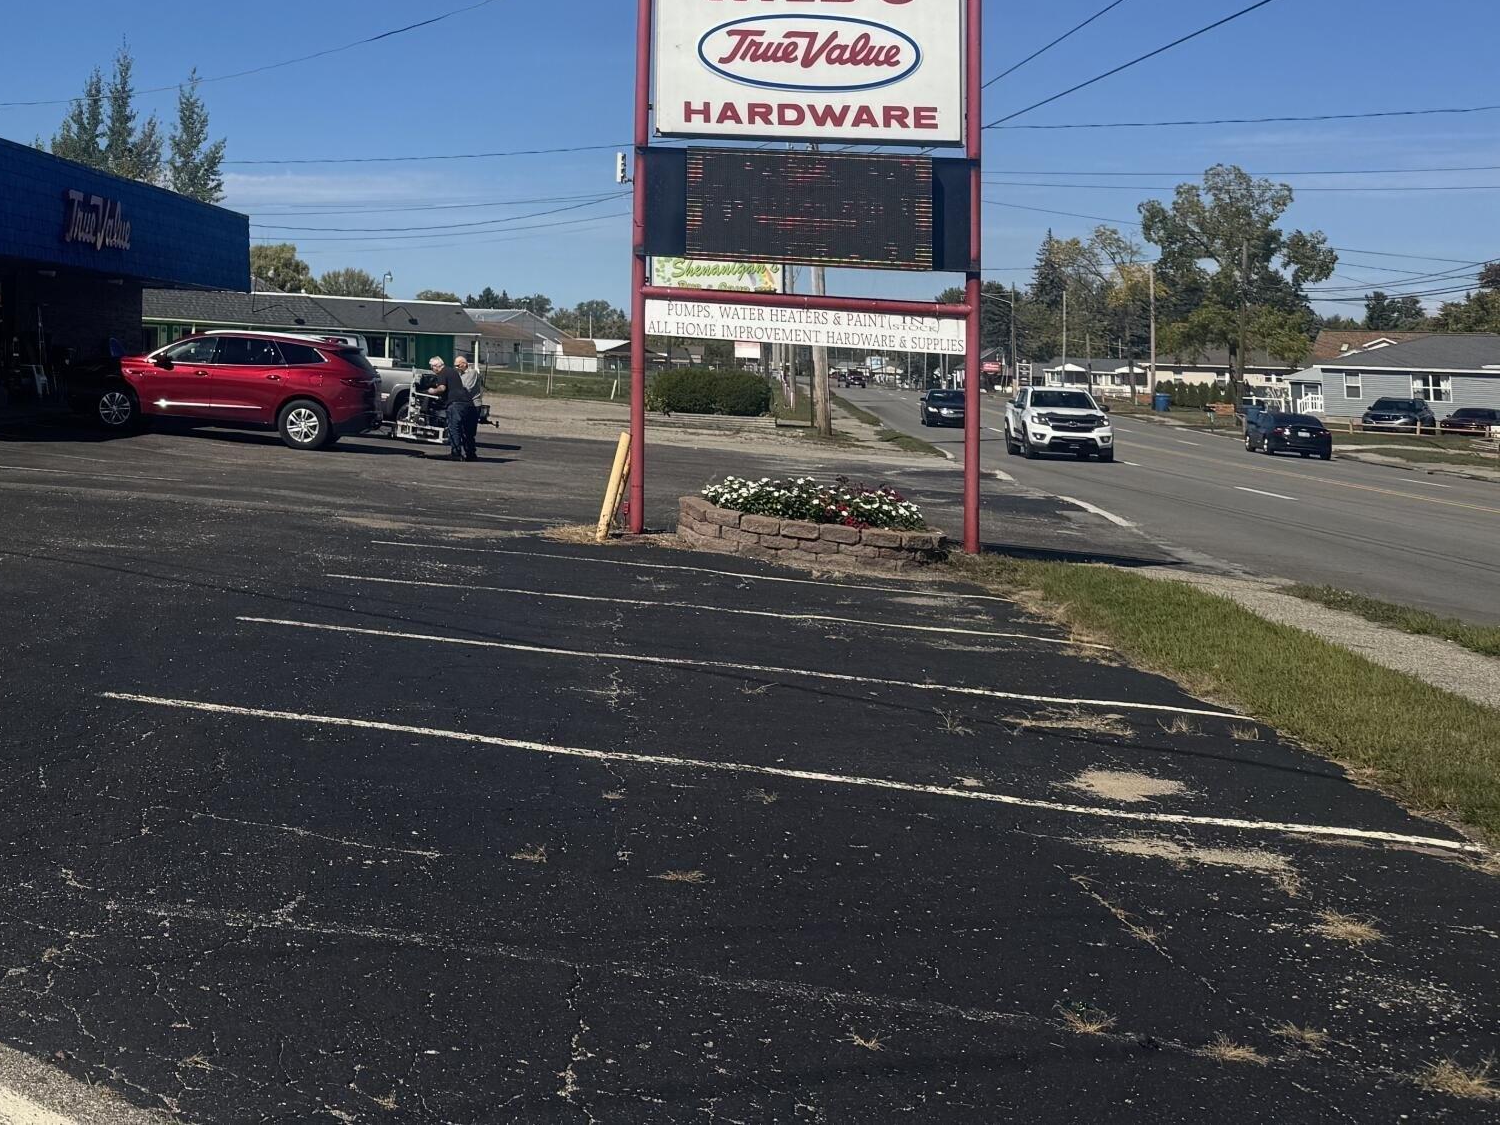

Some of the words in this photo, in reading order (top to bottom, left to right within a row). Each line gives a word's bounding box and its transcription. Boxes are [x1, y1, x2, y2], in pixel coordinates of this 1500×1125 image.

[683, 101, 939, 130] HARDWARE
[668, 303, 713, 319] PUMPS,
[719, 306, 765, 321] WATER
[770, 309, 828, 325] HEATERS
[833, 313, 841, 325] &
[648, 321, 671, 334] ALL
[676, 322, 716, 336] HOME
[722, 325, 820, 343] IMPROVEMENT
[827, 331, 896, 348] HARDWARE
[900, 336, 907, 348] &
[911, 336, 964, 352] SUPPLIES
